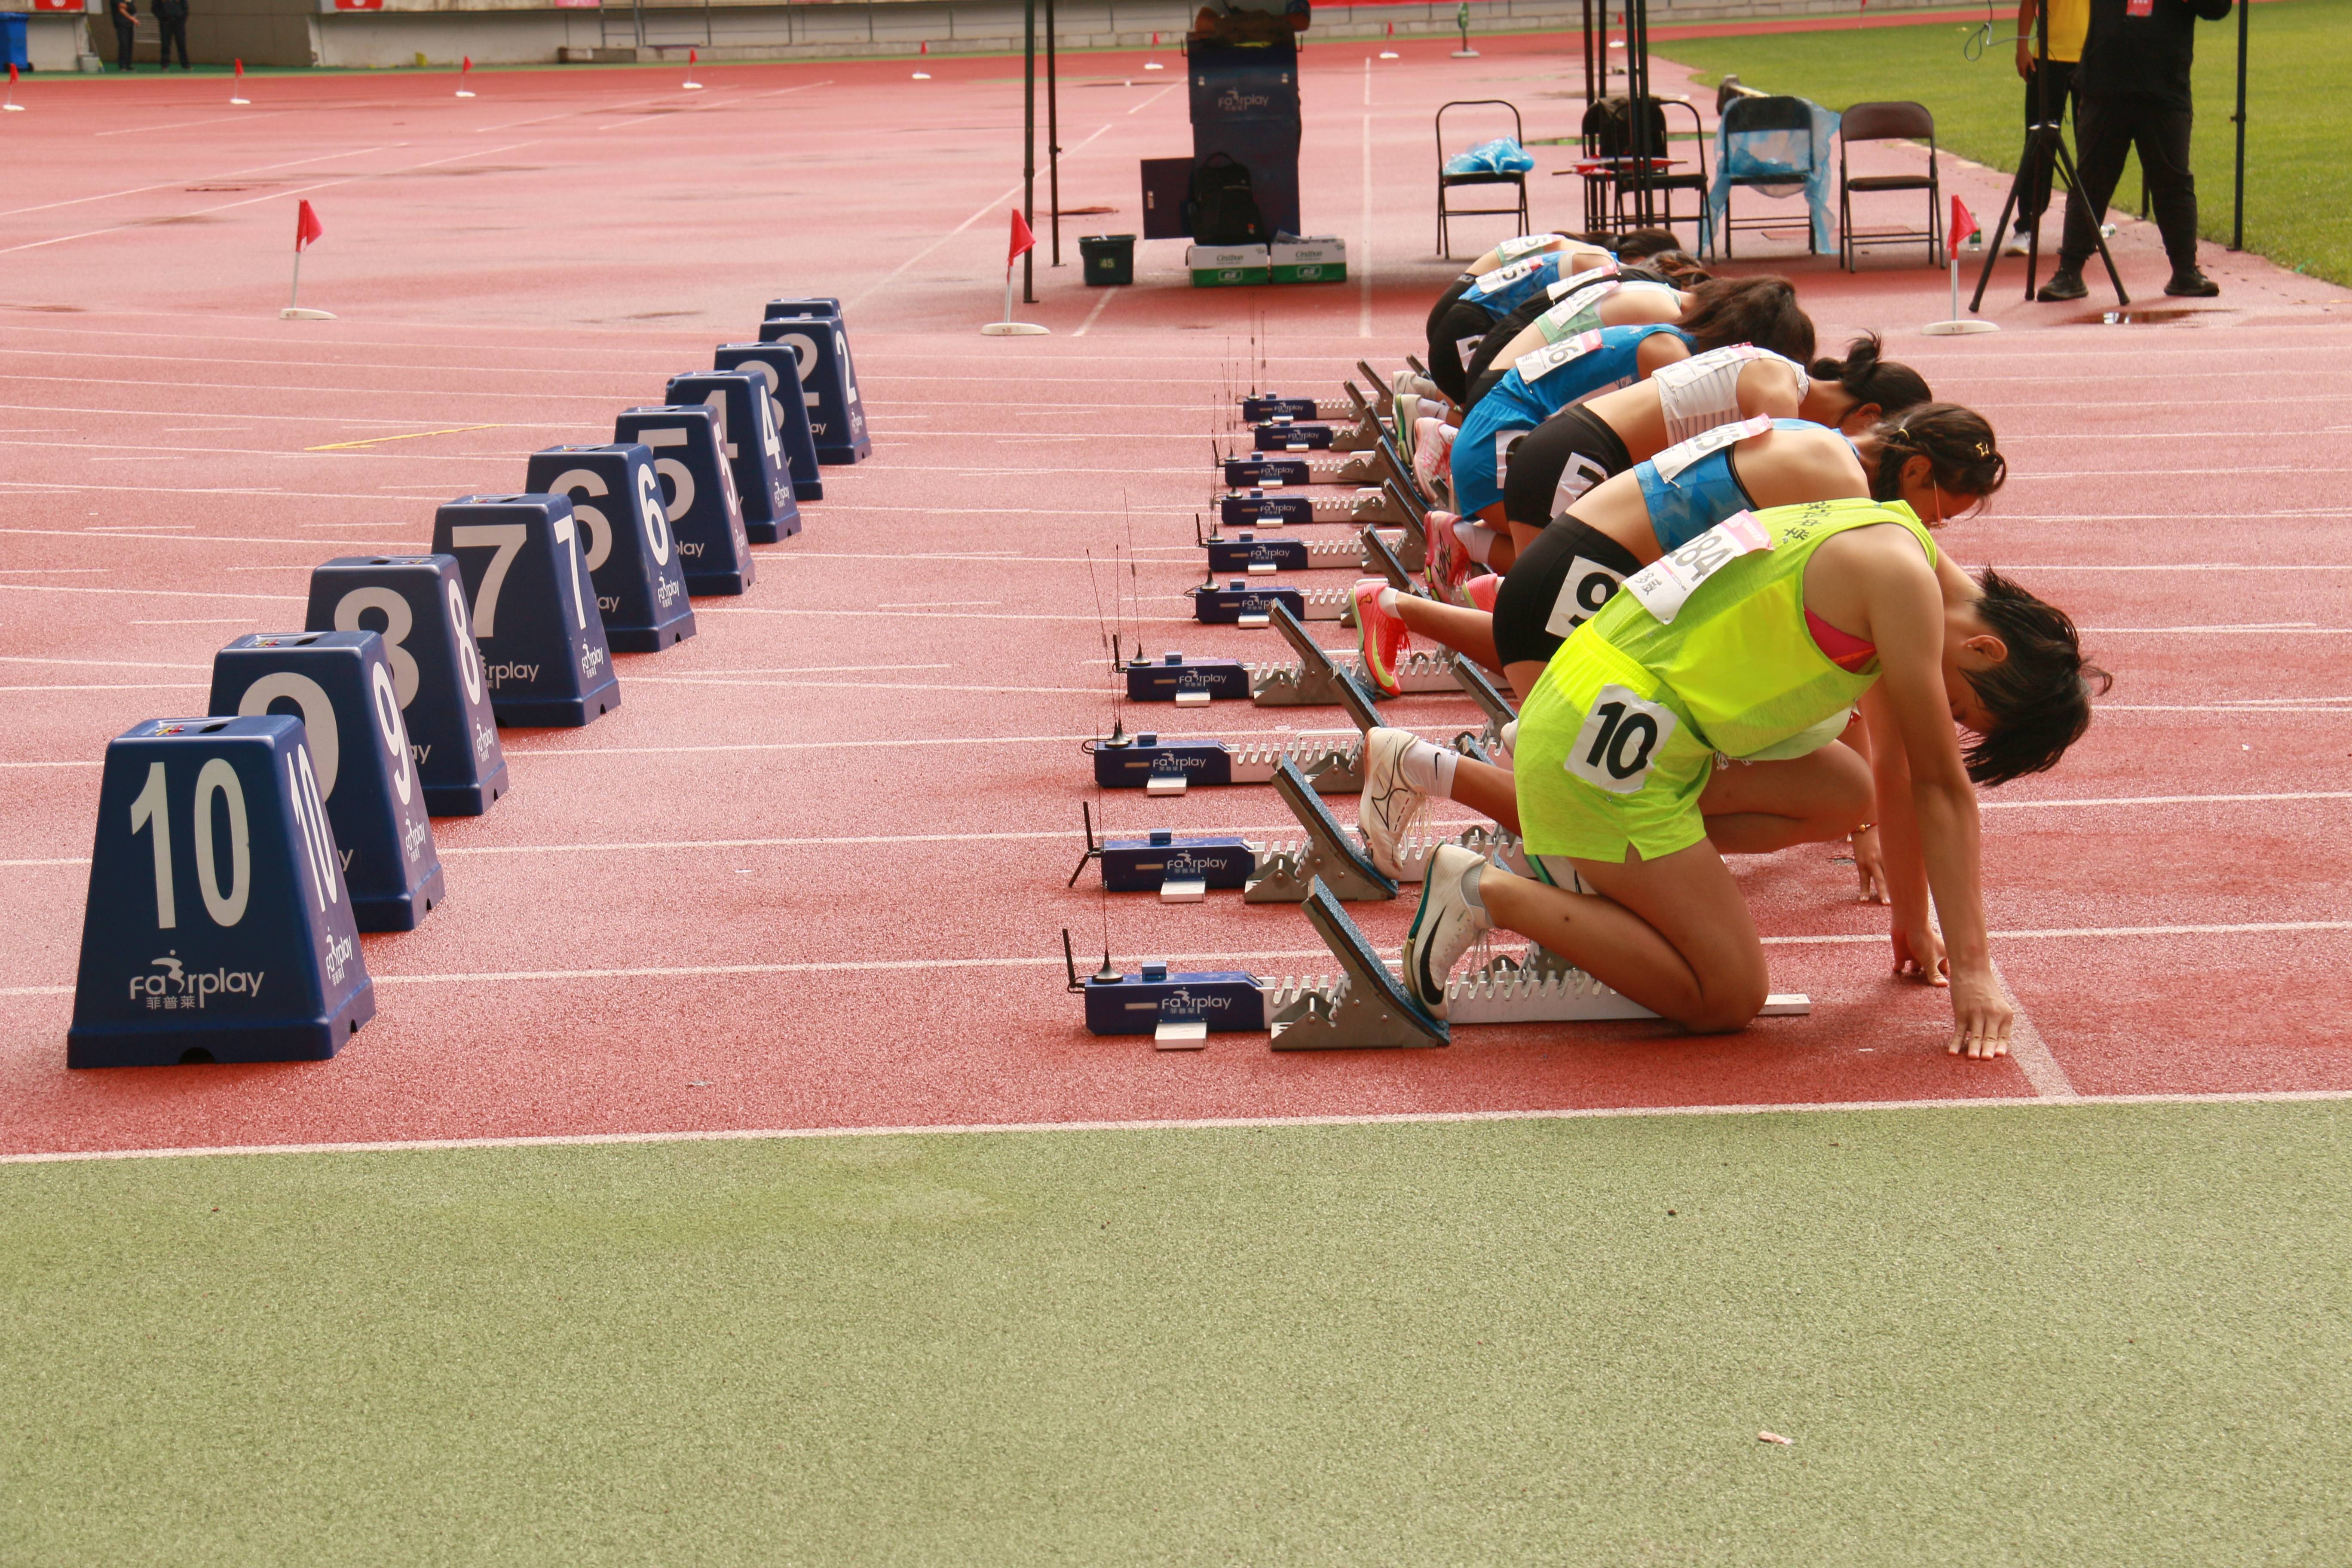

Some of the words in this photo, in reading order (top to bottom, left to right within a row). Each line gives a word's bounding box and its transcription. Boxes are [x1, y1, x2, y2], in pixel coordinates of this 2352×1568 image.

[835, 330, 857, 404] 2
[714, 422, 737, 516] 5
[760, 385, 781, 470] 4
[637, 427, 695, 522] 5
[638, 463, 669, 566] 6
[452, 524, 527, 638] 7
[553, 514, 587, 630] 7
[448, 579, 481, 705] 8
[1179, 668, 1227, 686] Fairplay
[373, 662, 411, 805] 9
[1153, 750, 1206, 771] Fairplay
[1586, 701, 1658, 779] 10
[130, 758, 251, 929] 10
[287, 744, 337, 913] 10
[1167, 850, 1227, 873] Fairplay
[130, 949, 265, 1008] Fairplay
[326, 926, 353, 979] Fairplay
[146, 995, 195, 1009] 菲普莱
[1162, 987, 1231, 1014] Fairplay
